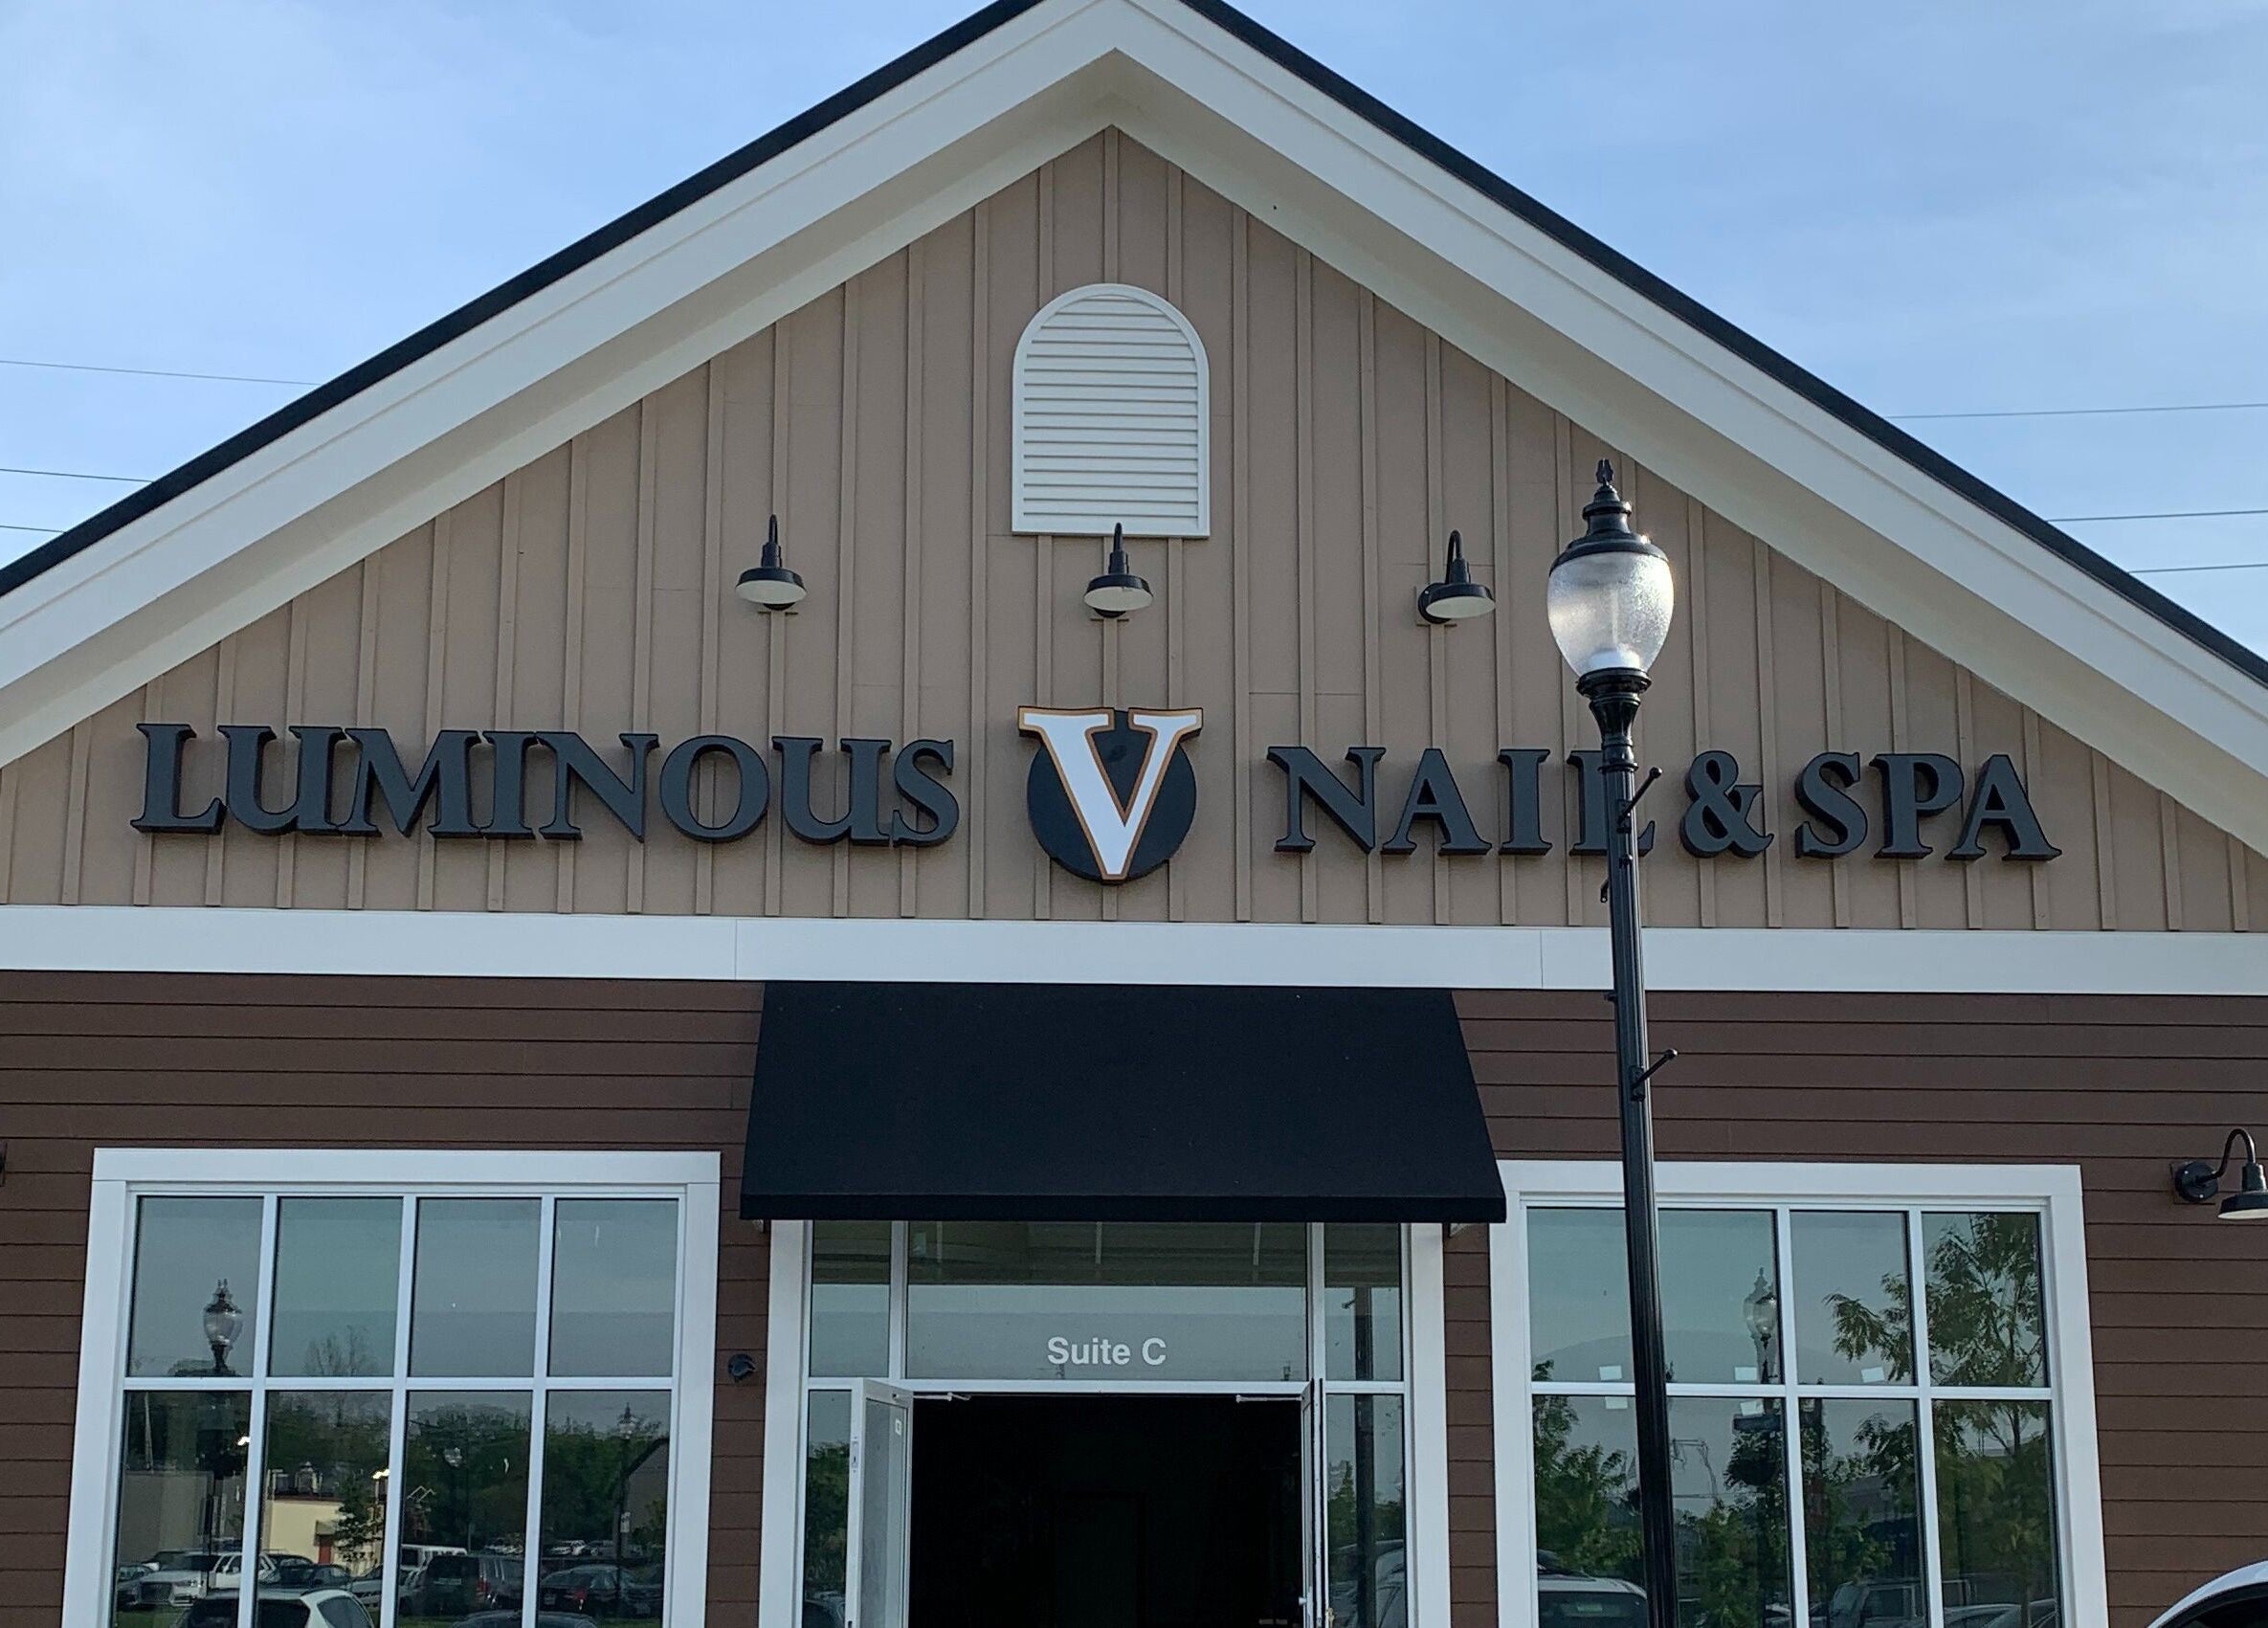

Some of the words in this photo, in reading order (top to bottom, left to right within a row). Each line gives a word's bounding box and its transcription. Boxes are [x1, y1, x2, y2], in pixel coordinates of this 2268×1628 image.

[131, 722, 960, 848] LUMINOUS
[1018, 705, 1203, 884] V
[1679, 750, 1776, 859] &
[1794, 751, 2063, 861] SPA
[1047, 1336, 1131, 1366] Suite
[1142, 1337, 1167, 1366] C
